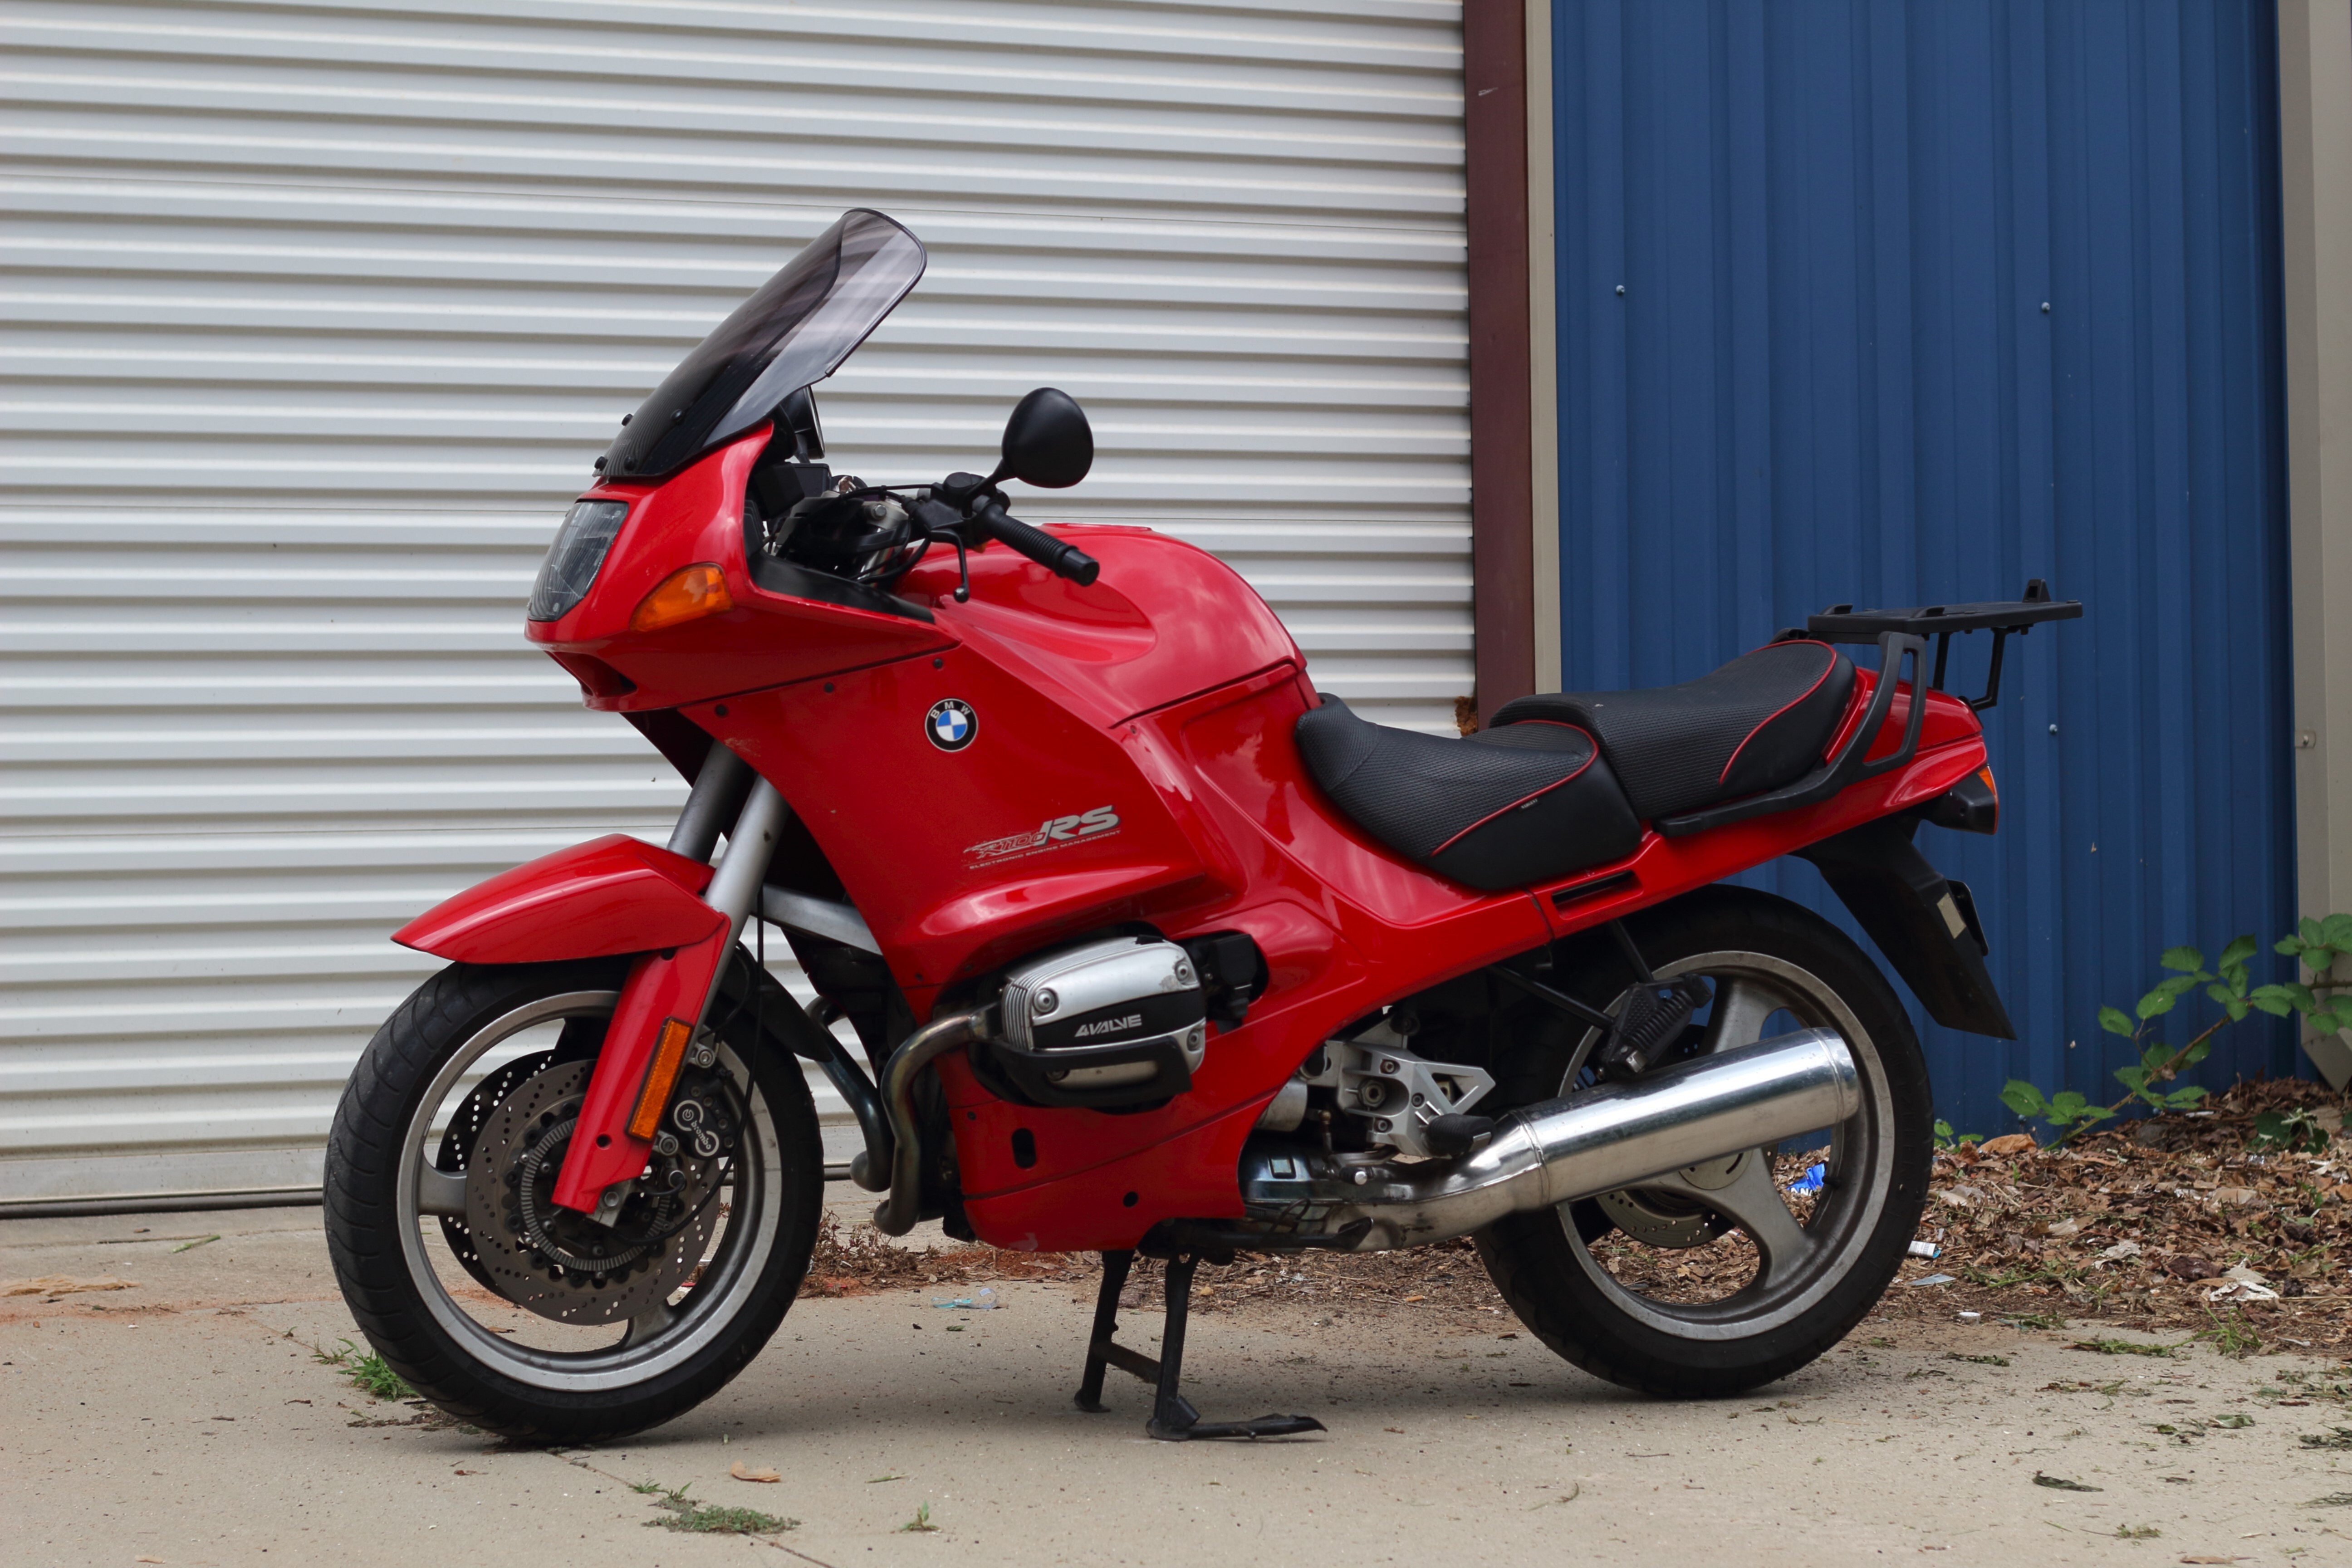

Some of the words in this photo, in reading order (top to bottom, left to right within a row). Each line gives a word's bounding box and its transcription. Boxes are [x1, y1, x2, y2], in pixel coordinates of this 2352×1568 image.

[930, 701, 971, 719] BMW
[969, 854, 1024, 869] ELECTRONIC
[1025, 844, 1058, 856] ENGINE
[1059, 830, 1121, 848] MANAGEMENT
[1074, 1014, 1142, 1037] 4VALVE
[690, 1120, 711, 1150] brembo
